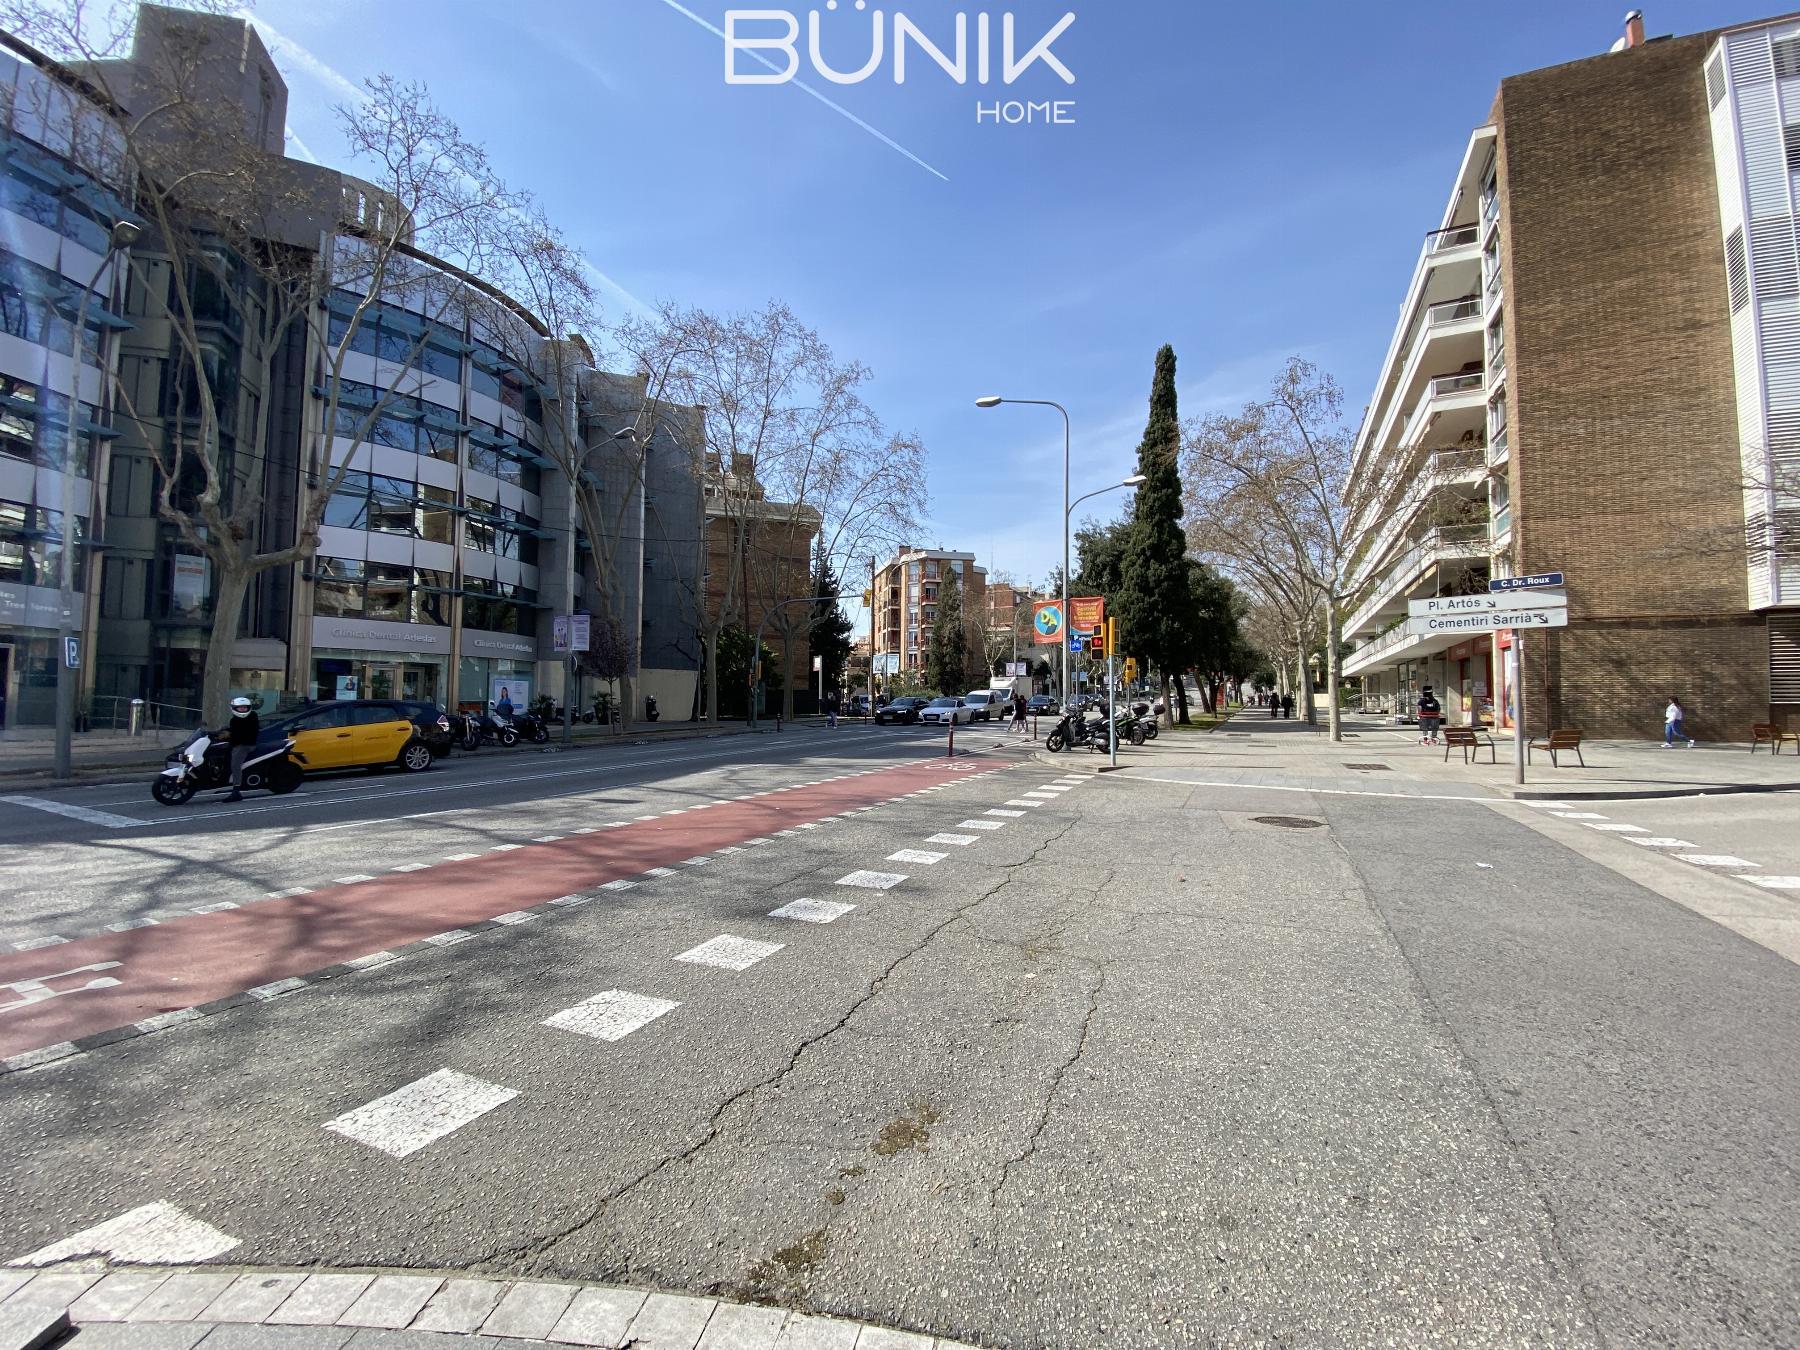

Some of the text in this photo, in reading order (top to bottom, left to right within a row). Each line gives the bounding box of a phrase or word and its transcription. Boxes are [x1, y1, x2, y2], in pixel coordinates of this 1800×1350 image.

[1513, 578, 1525, 586] Dr.
[1527, 576, 1550, 585] Roux
[1428, 598, 1481, 611] Pl. Artós
[1429, 612, 1532, 629] Cementiri Sarrià
[369, 630, 401, 641] Dental
